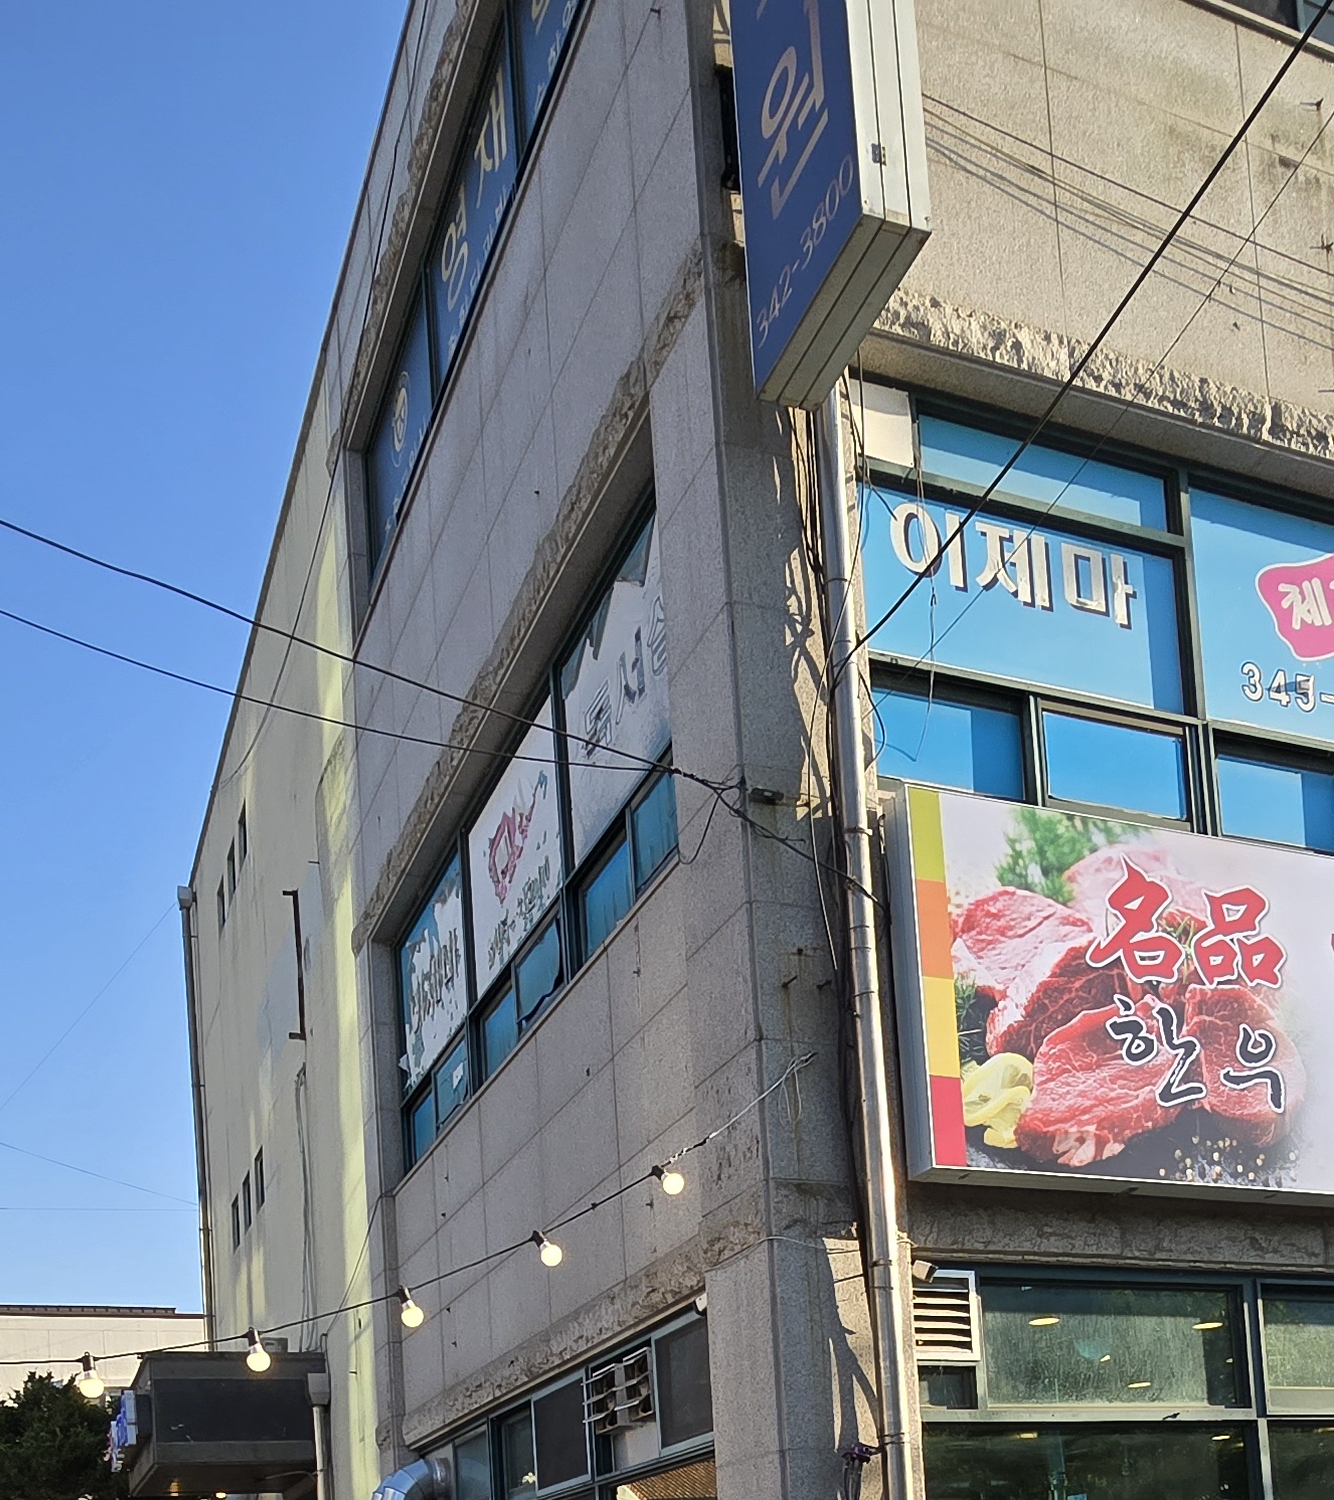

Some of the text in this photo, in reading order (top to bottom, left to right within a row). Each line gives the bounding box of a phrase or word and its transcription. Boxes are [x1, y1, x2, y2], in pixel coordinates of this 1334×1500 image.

[757, 154, 854, 349] 342-3800
[889, 500, 1139, 631] 이제마
[1086, 854, 1288, 990] 名品
[1104, 995, 1286, 1113] 한우
